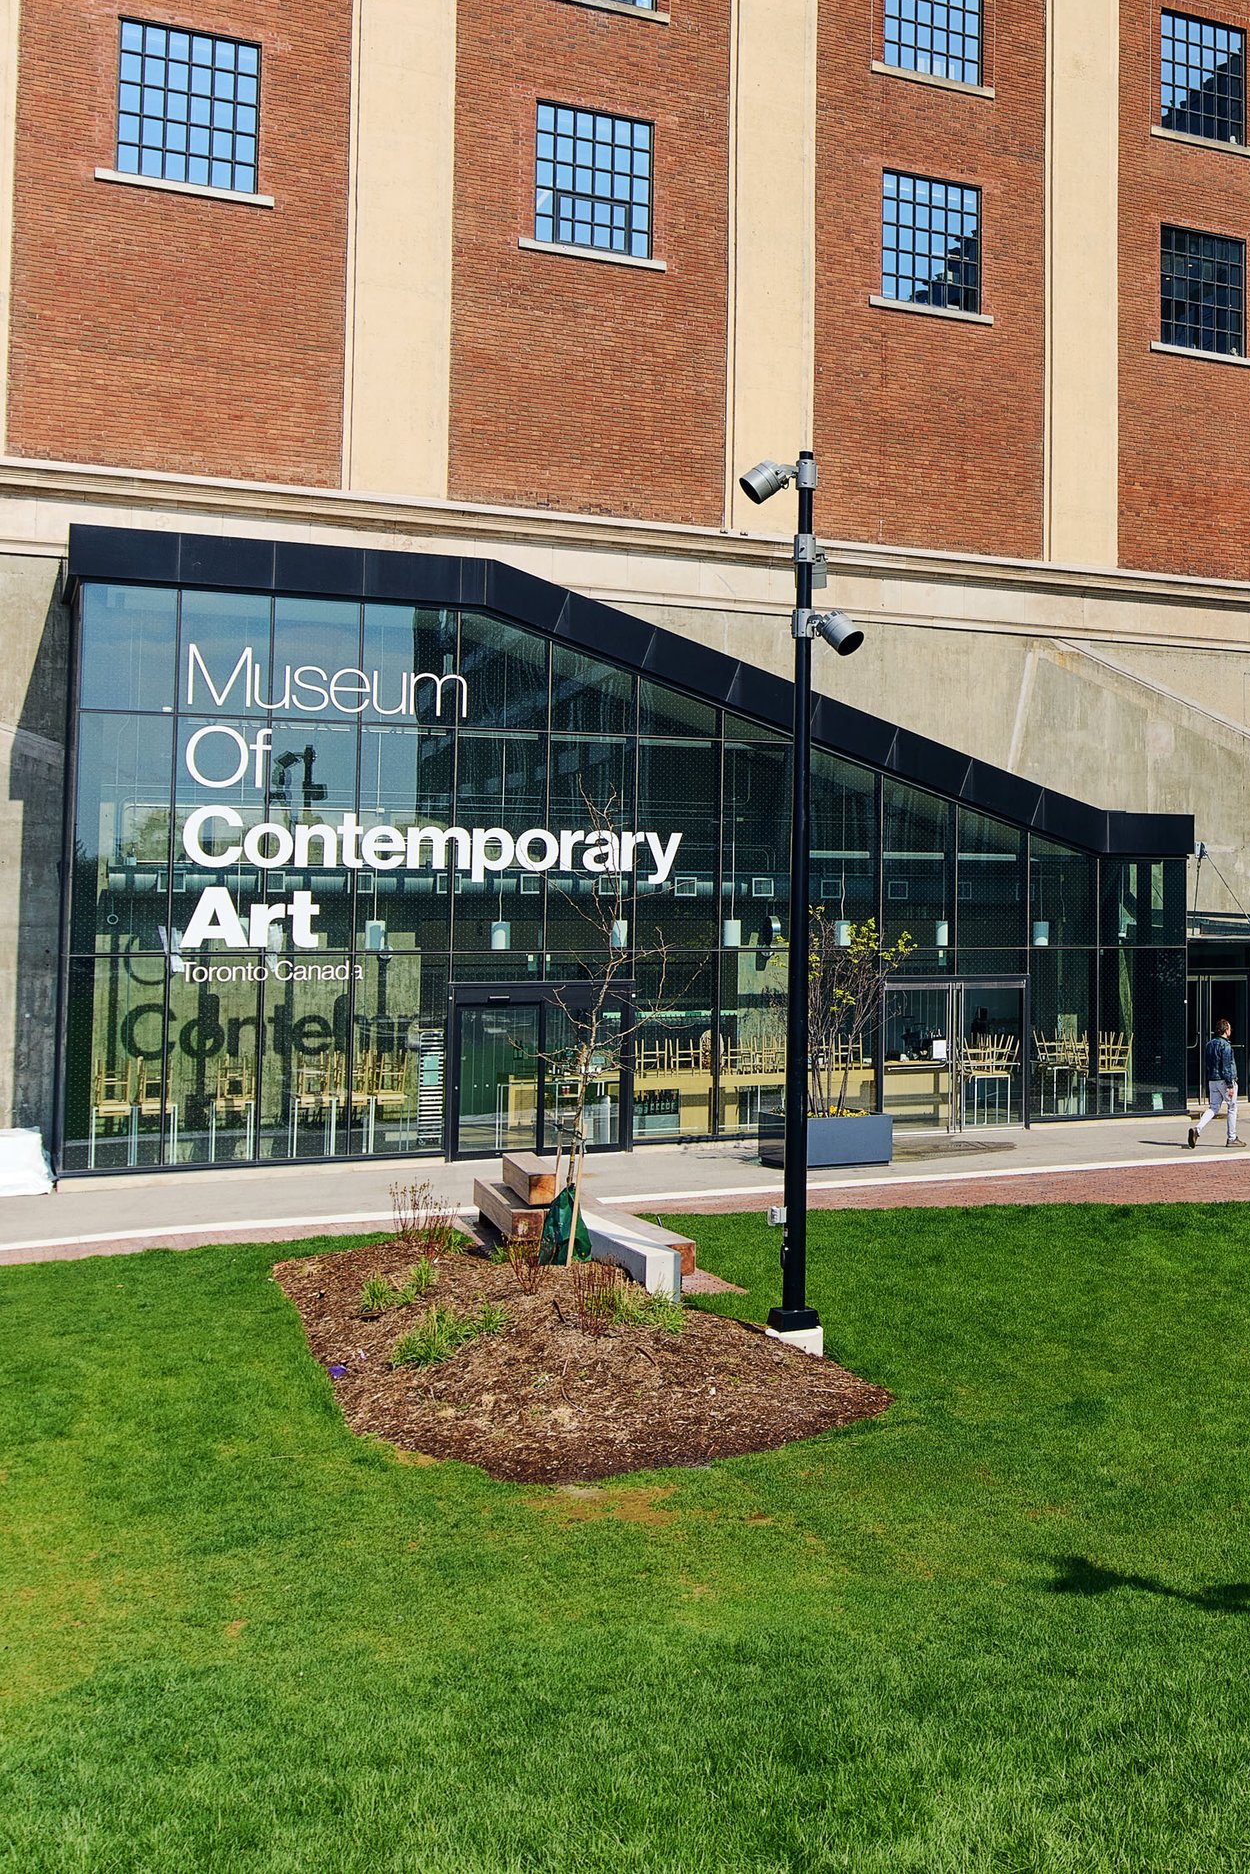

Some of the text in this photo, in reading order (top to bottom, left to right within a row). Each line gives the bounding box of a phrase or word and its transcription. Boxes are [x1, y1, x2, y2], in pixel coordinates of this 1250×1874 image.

[187, 643, 468, 718] Museum
[185, 726, 272, 789] Of
[182, 805, 682, 884] Contemporary
[180, 887, 320, 949] Art
[182, 960, 363, 983] Toronto Canada
